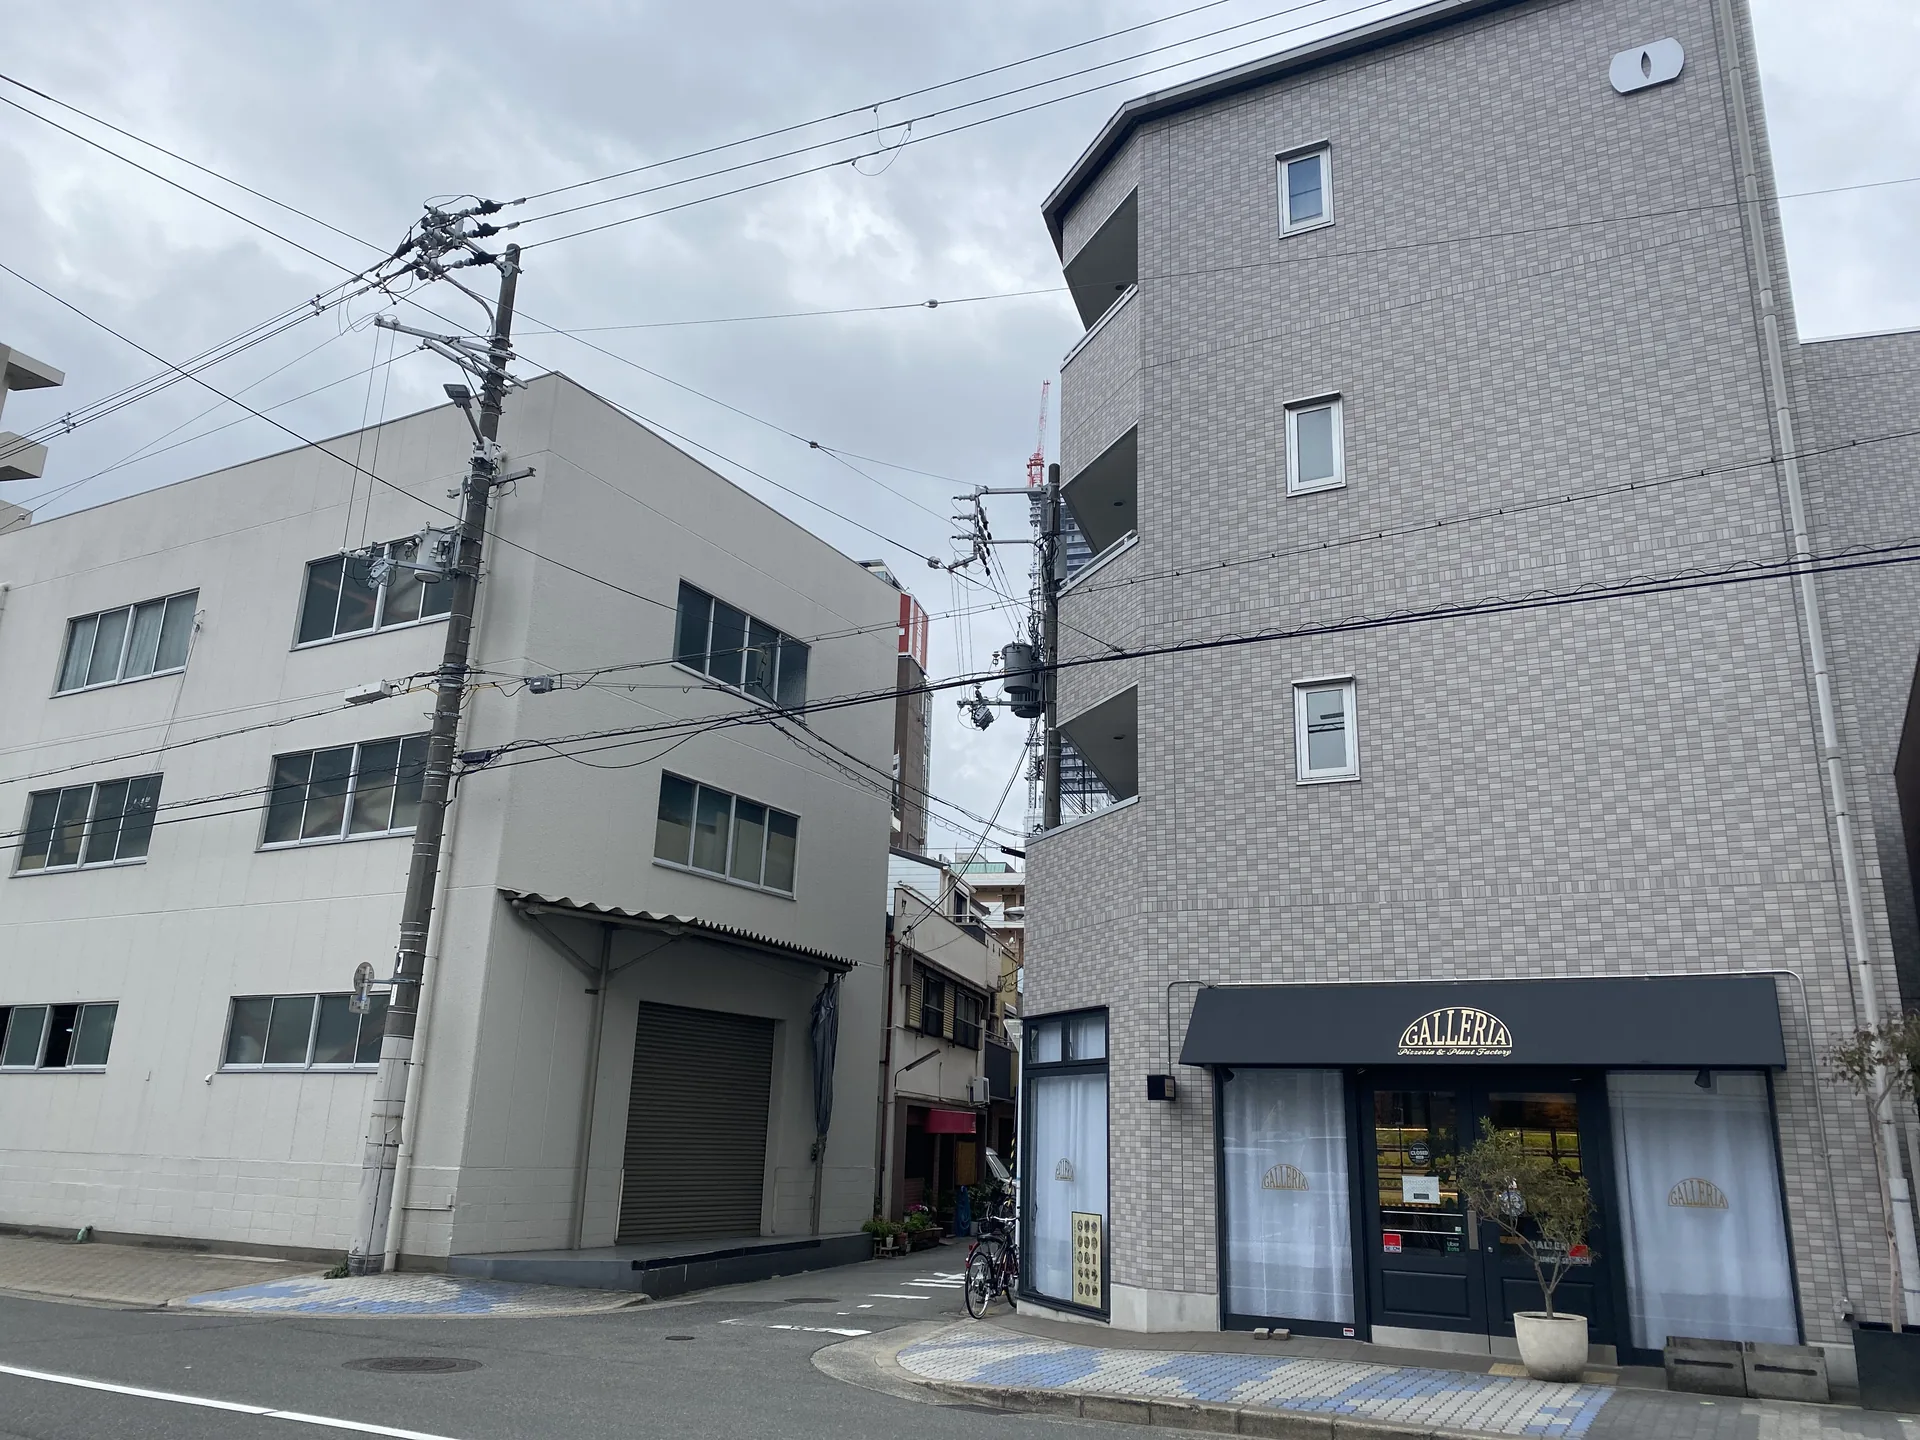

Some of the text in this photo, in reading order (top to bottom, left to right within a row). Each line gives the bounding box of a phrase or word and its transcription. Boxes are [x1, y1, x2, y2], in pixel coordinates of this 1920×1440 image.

[1405, 1010, 1507, 1046] GALLERIA
[1397, 1048, 1512, 1058] Pizzeria & Plant Factory
[1263, 1165, 1307, 1189] GALLERIA
[1670, 1180, 1726, 1207] GALLERIA
